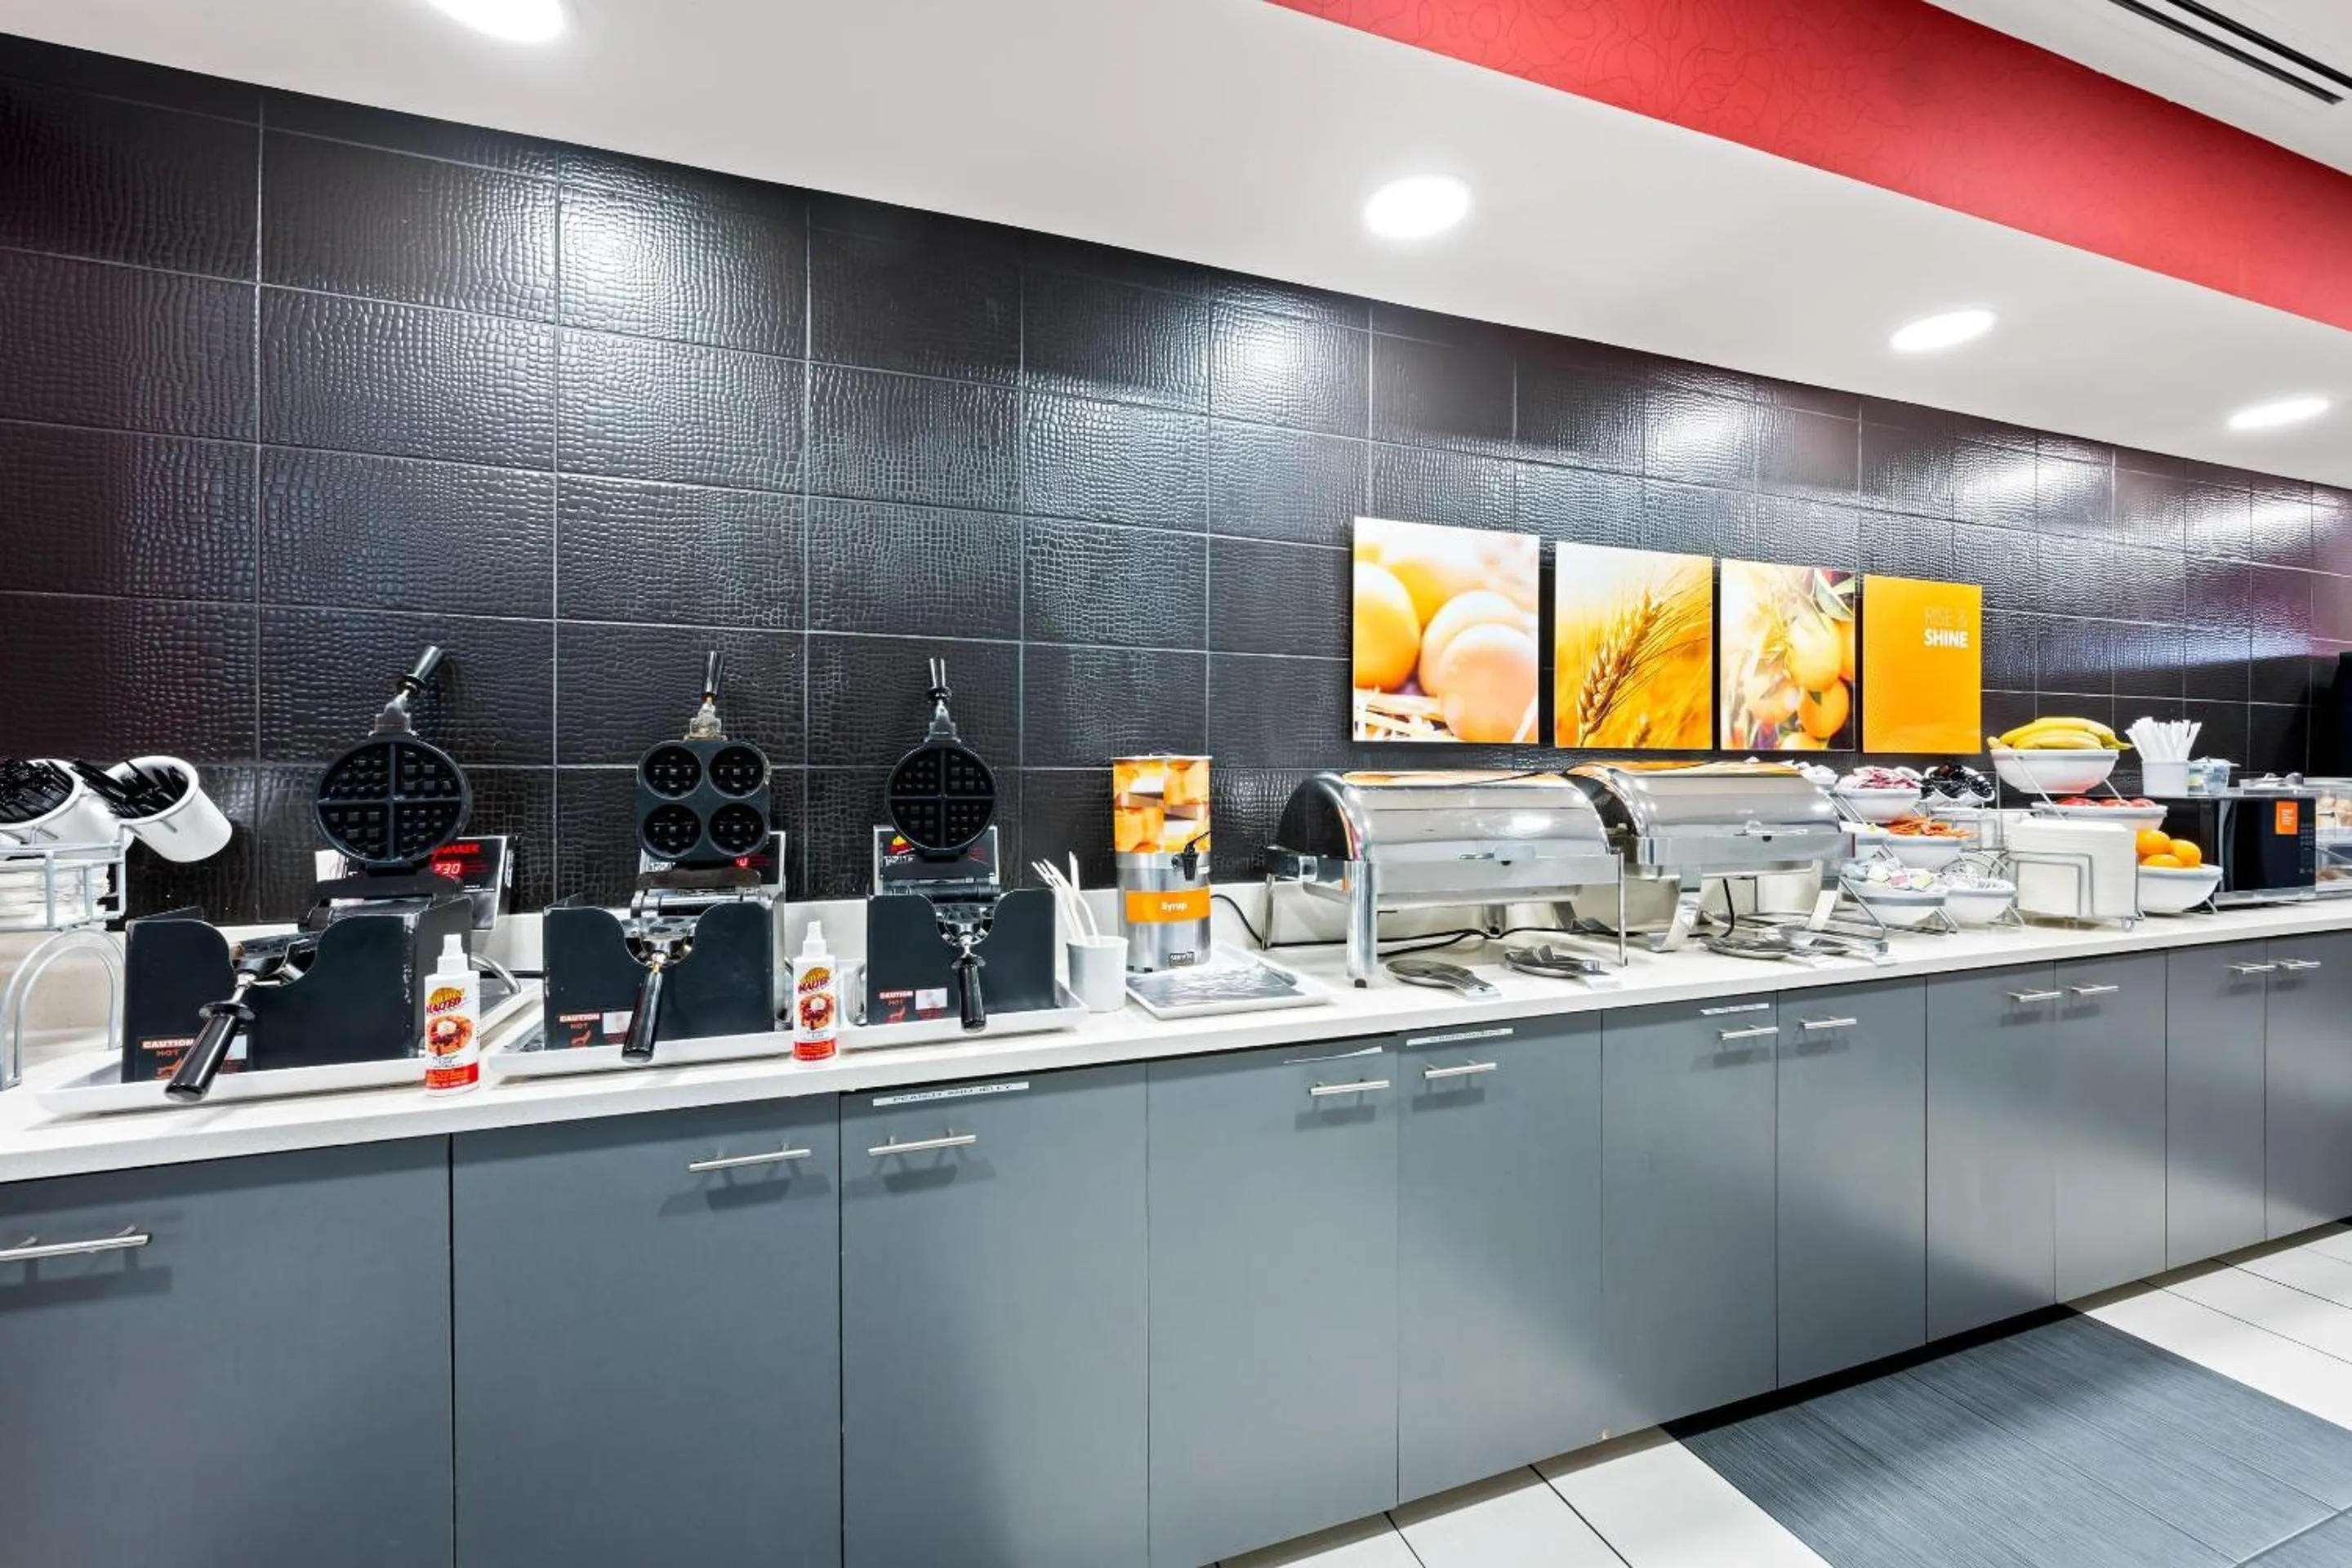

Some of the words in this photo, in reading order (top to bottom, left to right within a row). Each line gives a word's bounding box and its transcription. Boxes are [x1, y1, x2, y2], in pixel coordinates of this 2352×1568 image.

[1924, 607, 1954, 627] RISE
[1923, 628, 1969, 648] SHINE
[1160, 902, 1187, 912] Syrup
[880, 991, 913, 999] CAUTION
[559, 1013, 600, 1022] CAUTION
[142, 1039, 194, 1049] CAUTION
